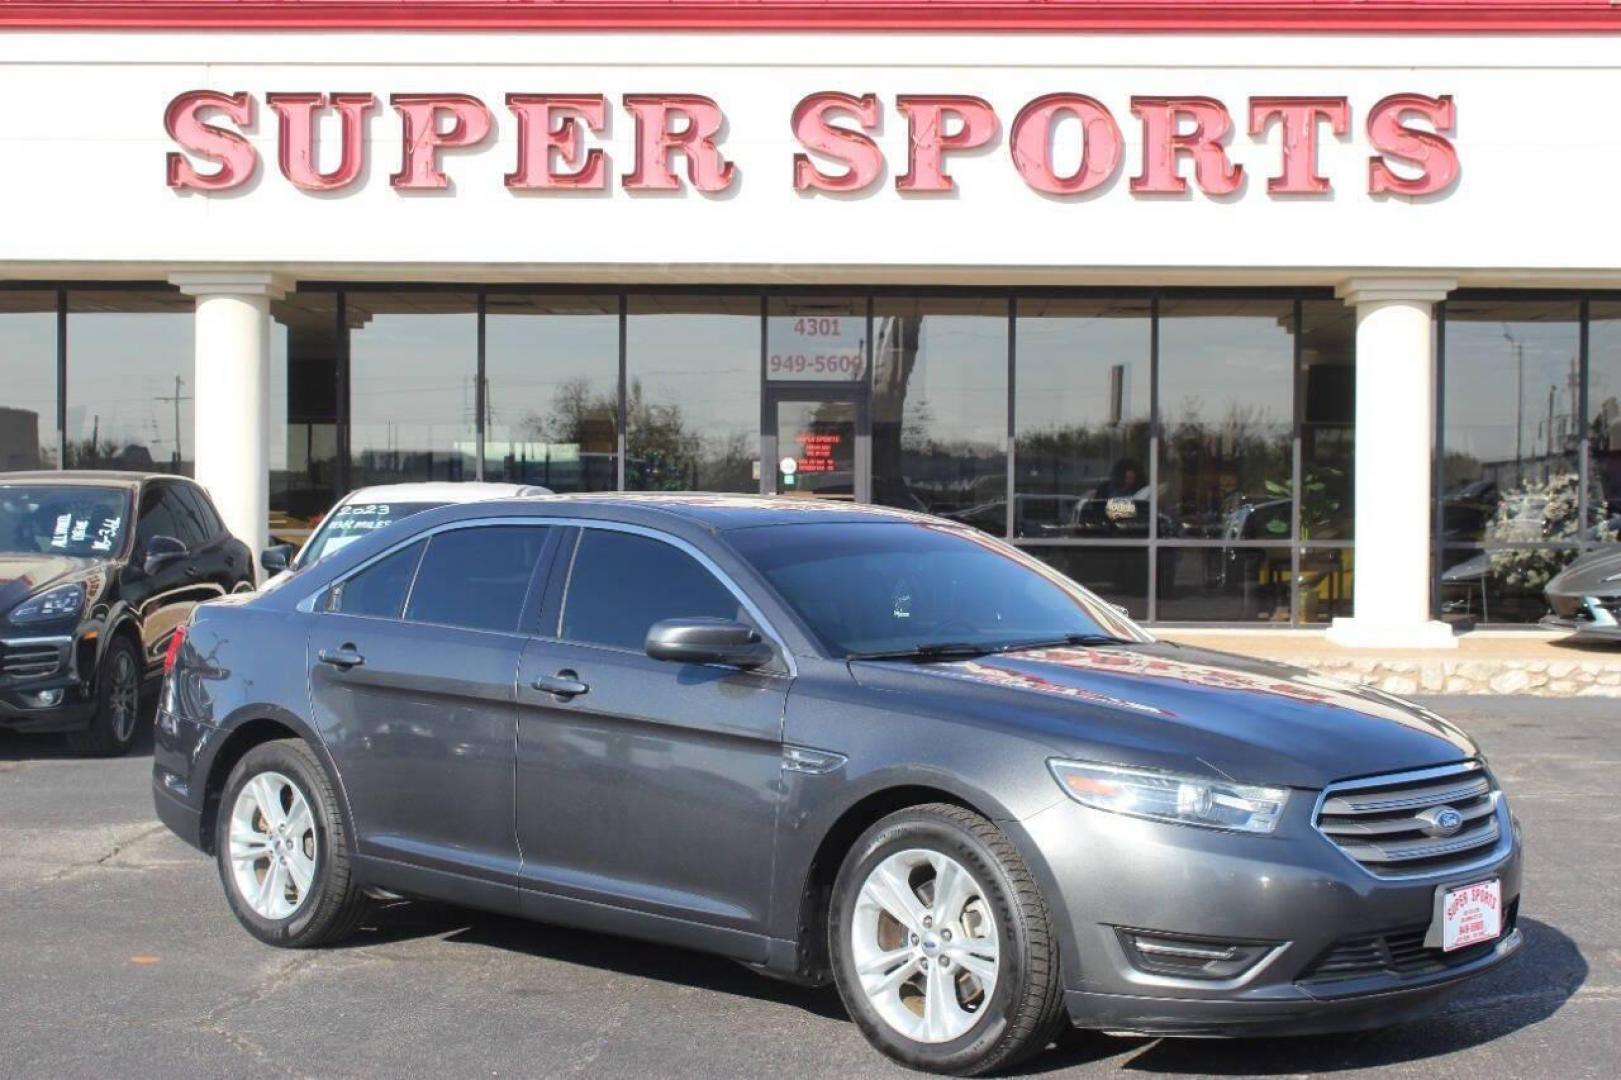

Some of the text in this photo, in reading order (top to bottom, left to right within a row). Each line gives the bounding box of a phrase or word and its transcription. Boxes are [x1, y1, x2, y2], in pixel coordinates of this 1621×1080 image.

[163, 89, 1460, 196] SUPER SPORTS
[793, 318, 841, 337] 4301
[769, 354, 864, 374] 949-5609
[338, 504, 391, 515] 2023
